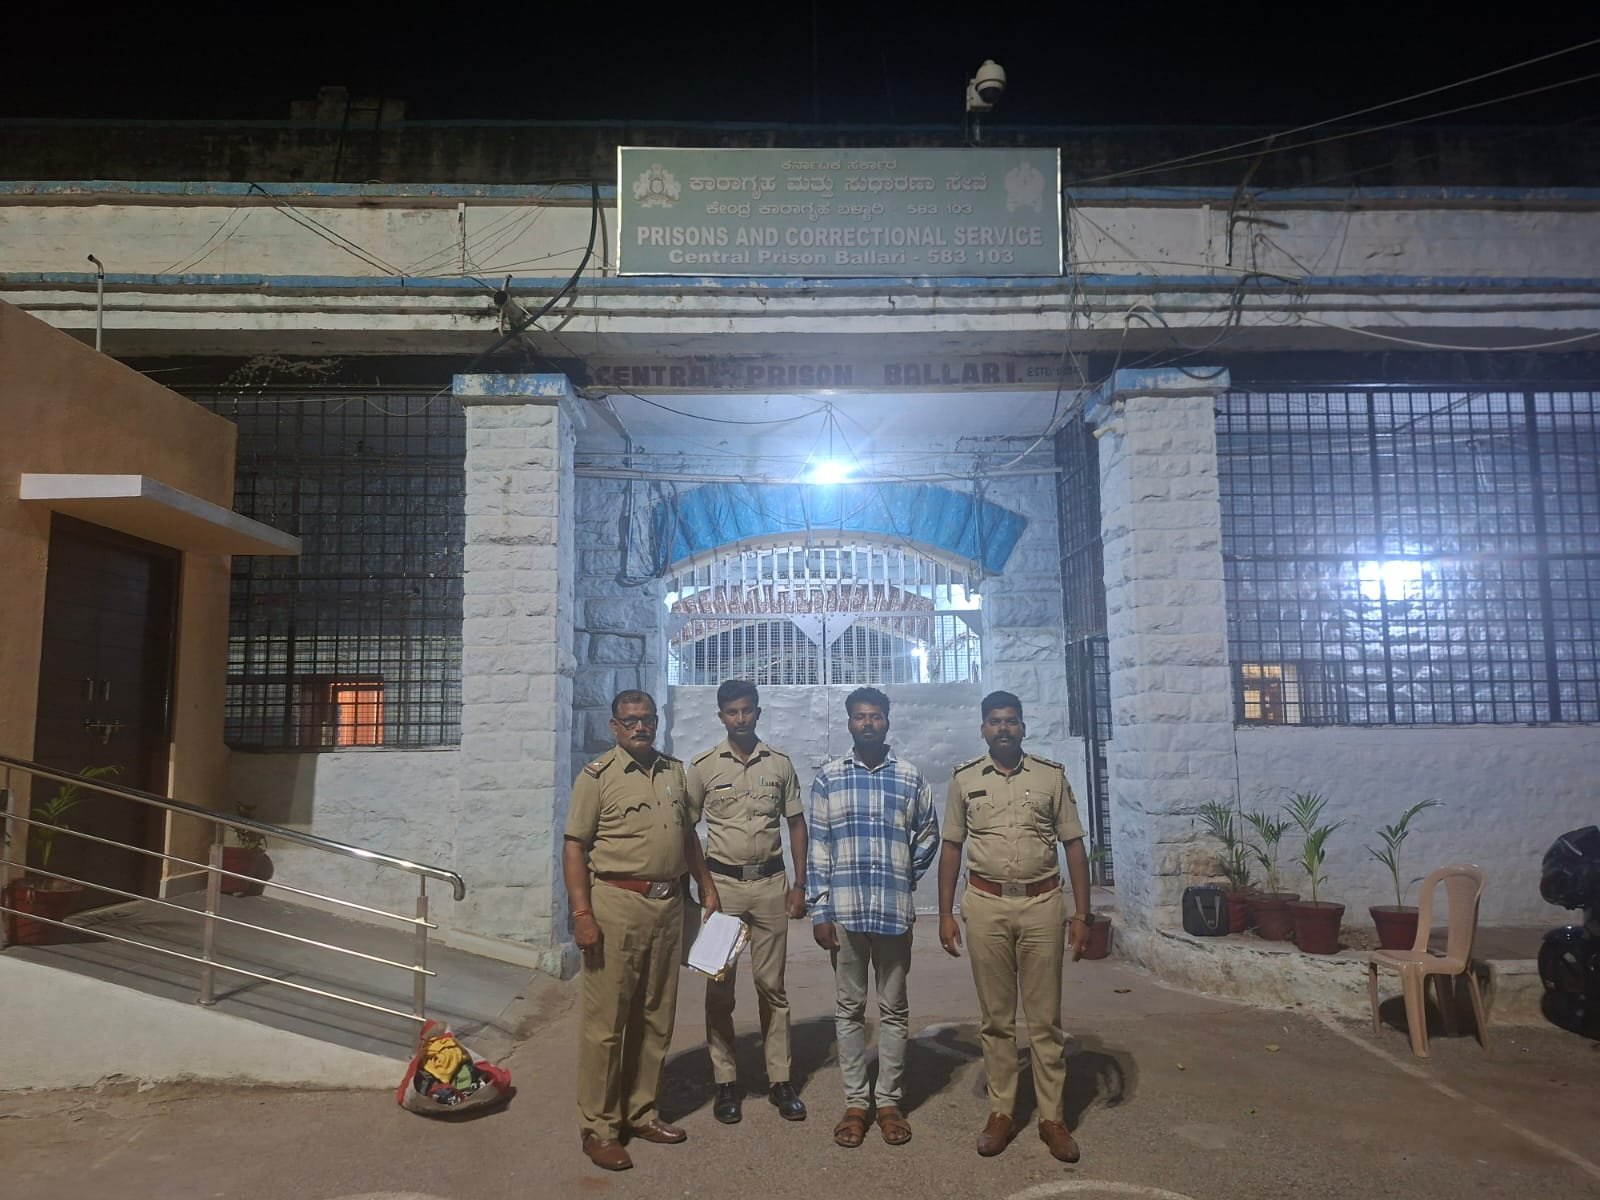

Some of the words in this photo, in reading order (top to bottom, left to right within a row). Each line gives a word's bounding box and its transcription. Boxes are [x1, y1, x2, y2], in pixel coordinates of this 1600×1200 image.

[689, 175, 777, 200] ಕಾರಾಗೃಹ
[786, 175, 834, 198] ಮತ್ತು
[906, 204, 938, 215] 583
[946, 204, 974, 215] 103
[637, 226, 729, 247] PRISONS
[735, 226, 778, 247] AND
[785, 226, 947, 247] CORRECTIONAL
[954, 226, 1043, 247] SERVICE
[669, 249, 750, 265] Central
[758, 249, 827, 265] Prison
[834, 249, 906, 265] Ballari
[927, 249, 967, 265] 583
[975, 249, 1015, 265] 103
[747, 364, 853, 386] PRISON
